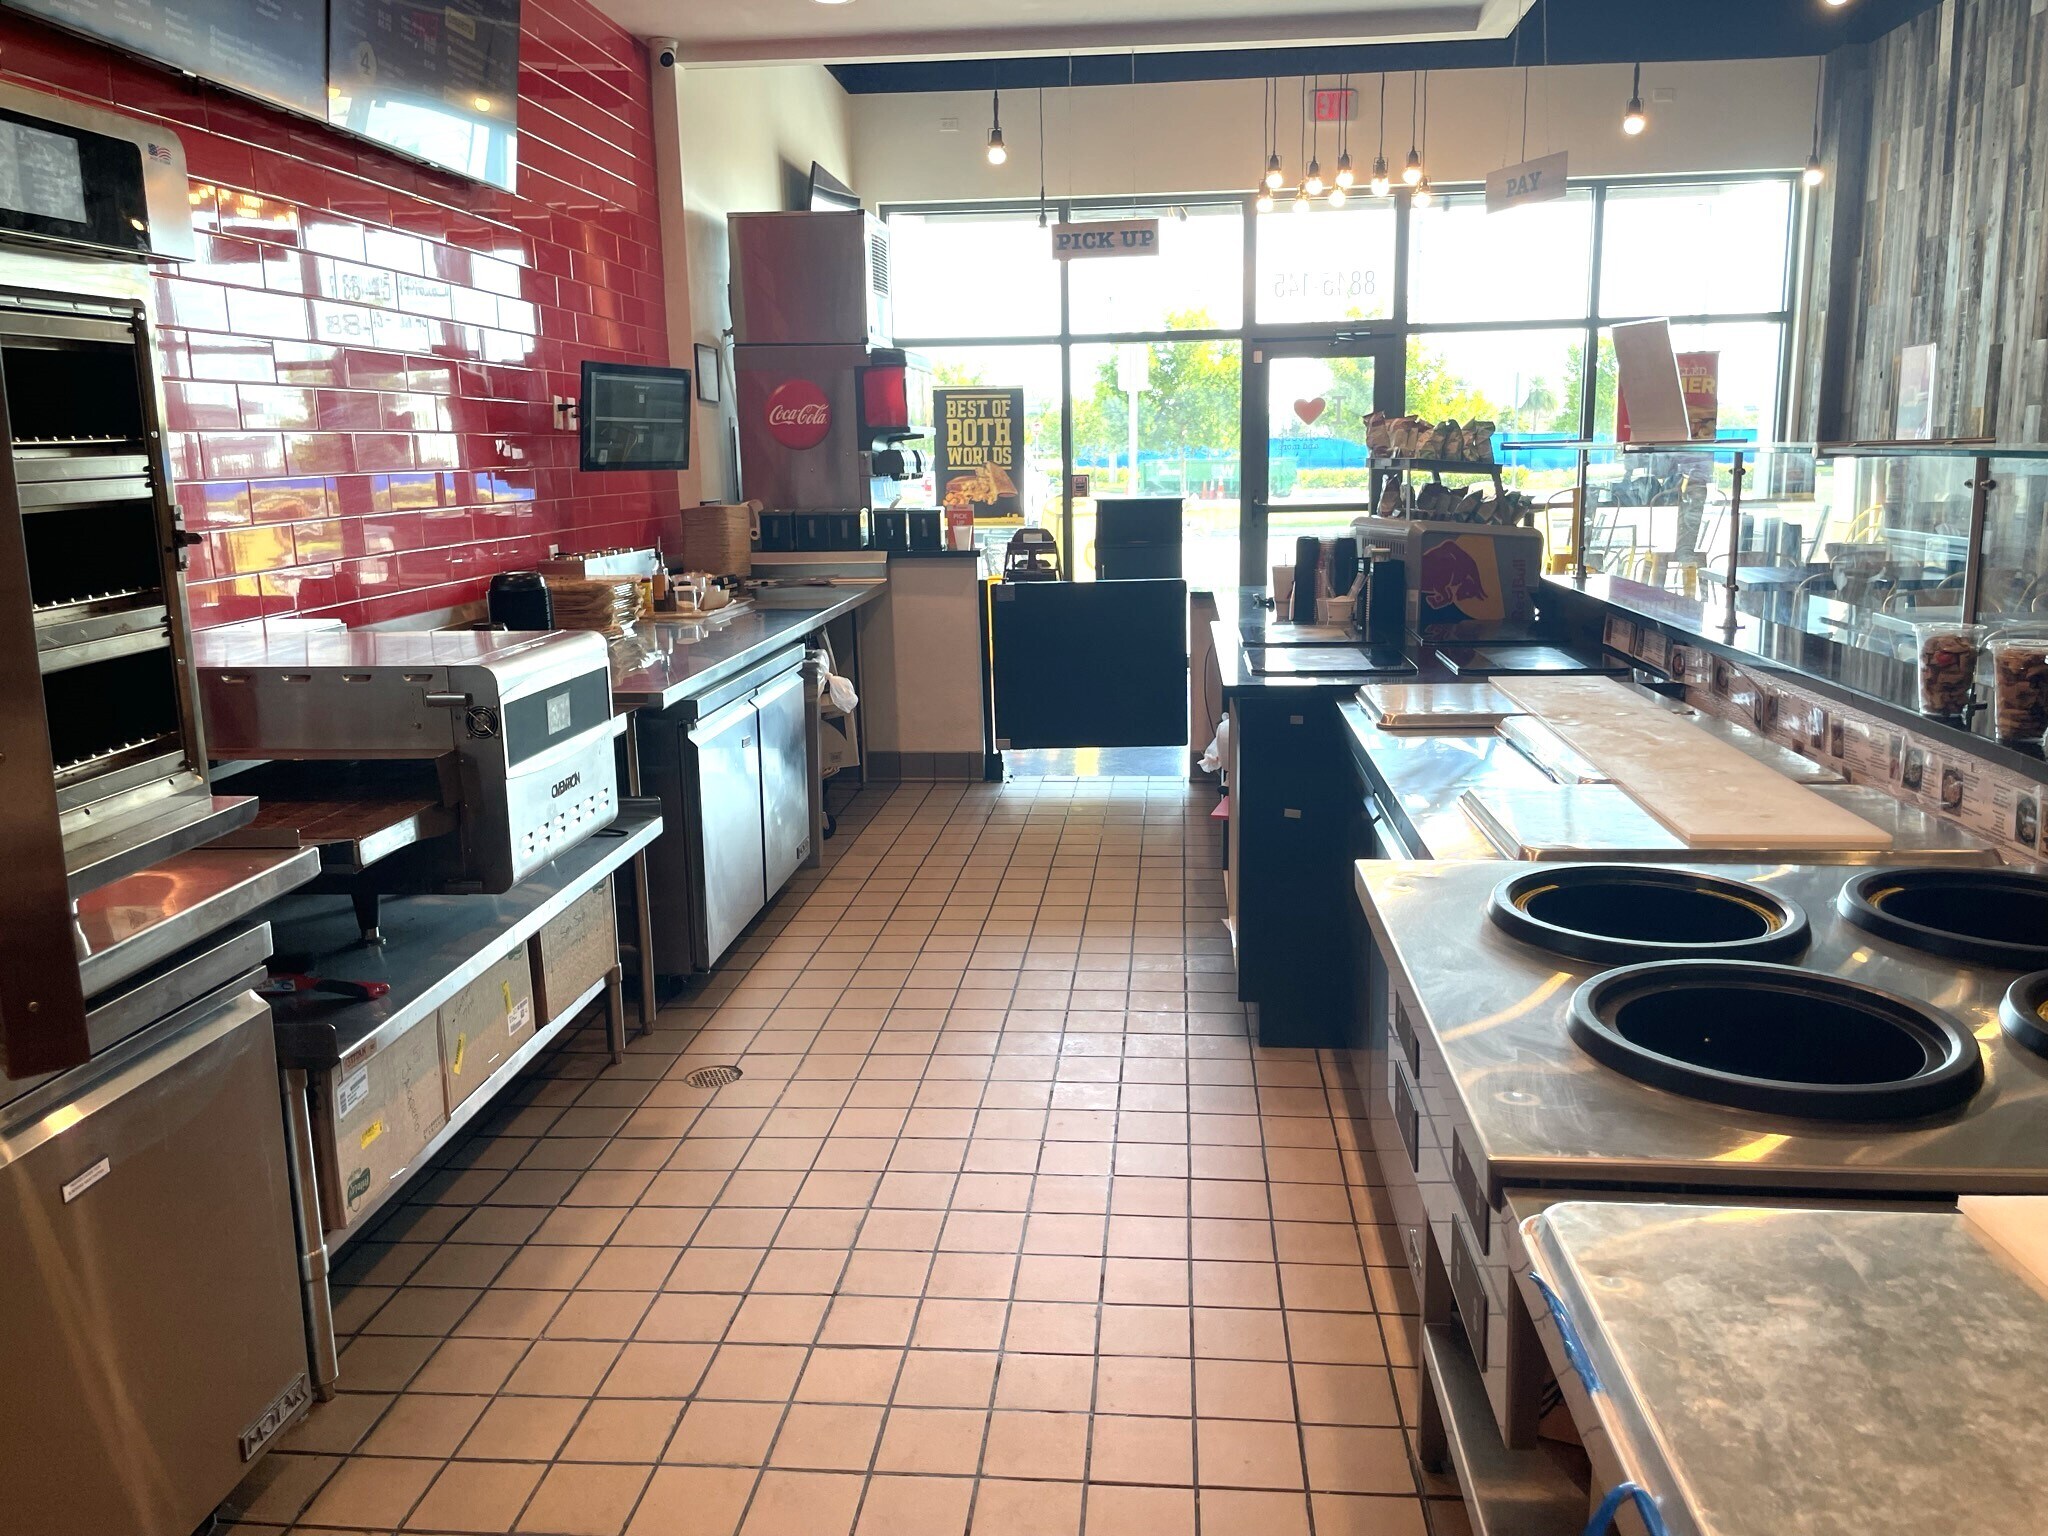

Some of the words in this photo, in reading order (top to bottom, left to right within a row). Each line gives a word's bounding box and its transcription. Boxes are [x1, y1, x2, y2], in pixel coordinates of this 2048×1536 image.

[1505, 171, 1542, 198] PAY
[1056, 231, 1115, 251] PICK
[1120, 229, 1155, 248] UP
[769, 403, 829, 426] Coca-Cola
[946, 399, 988, 418] BEST
[992, 399, 1012, 418] OF
[946, 418, 1012, 447] BOTH
[947, 447, 1012, 466] WORLDS
